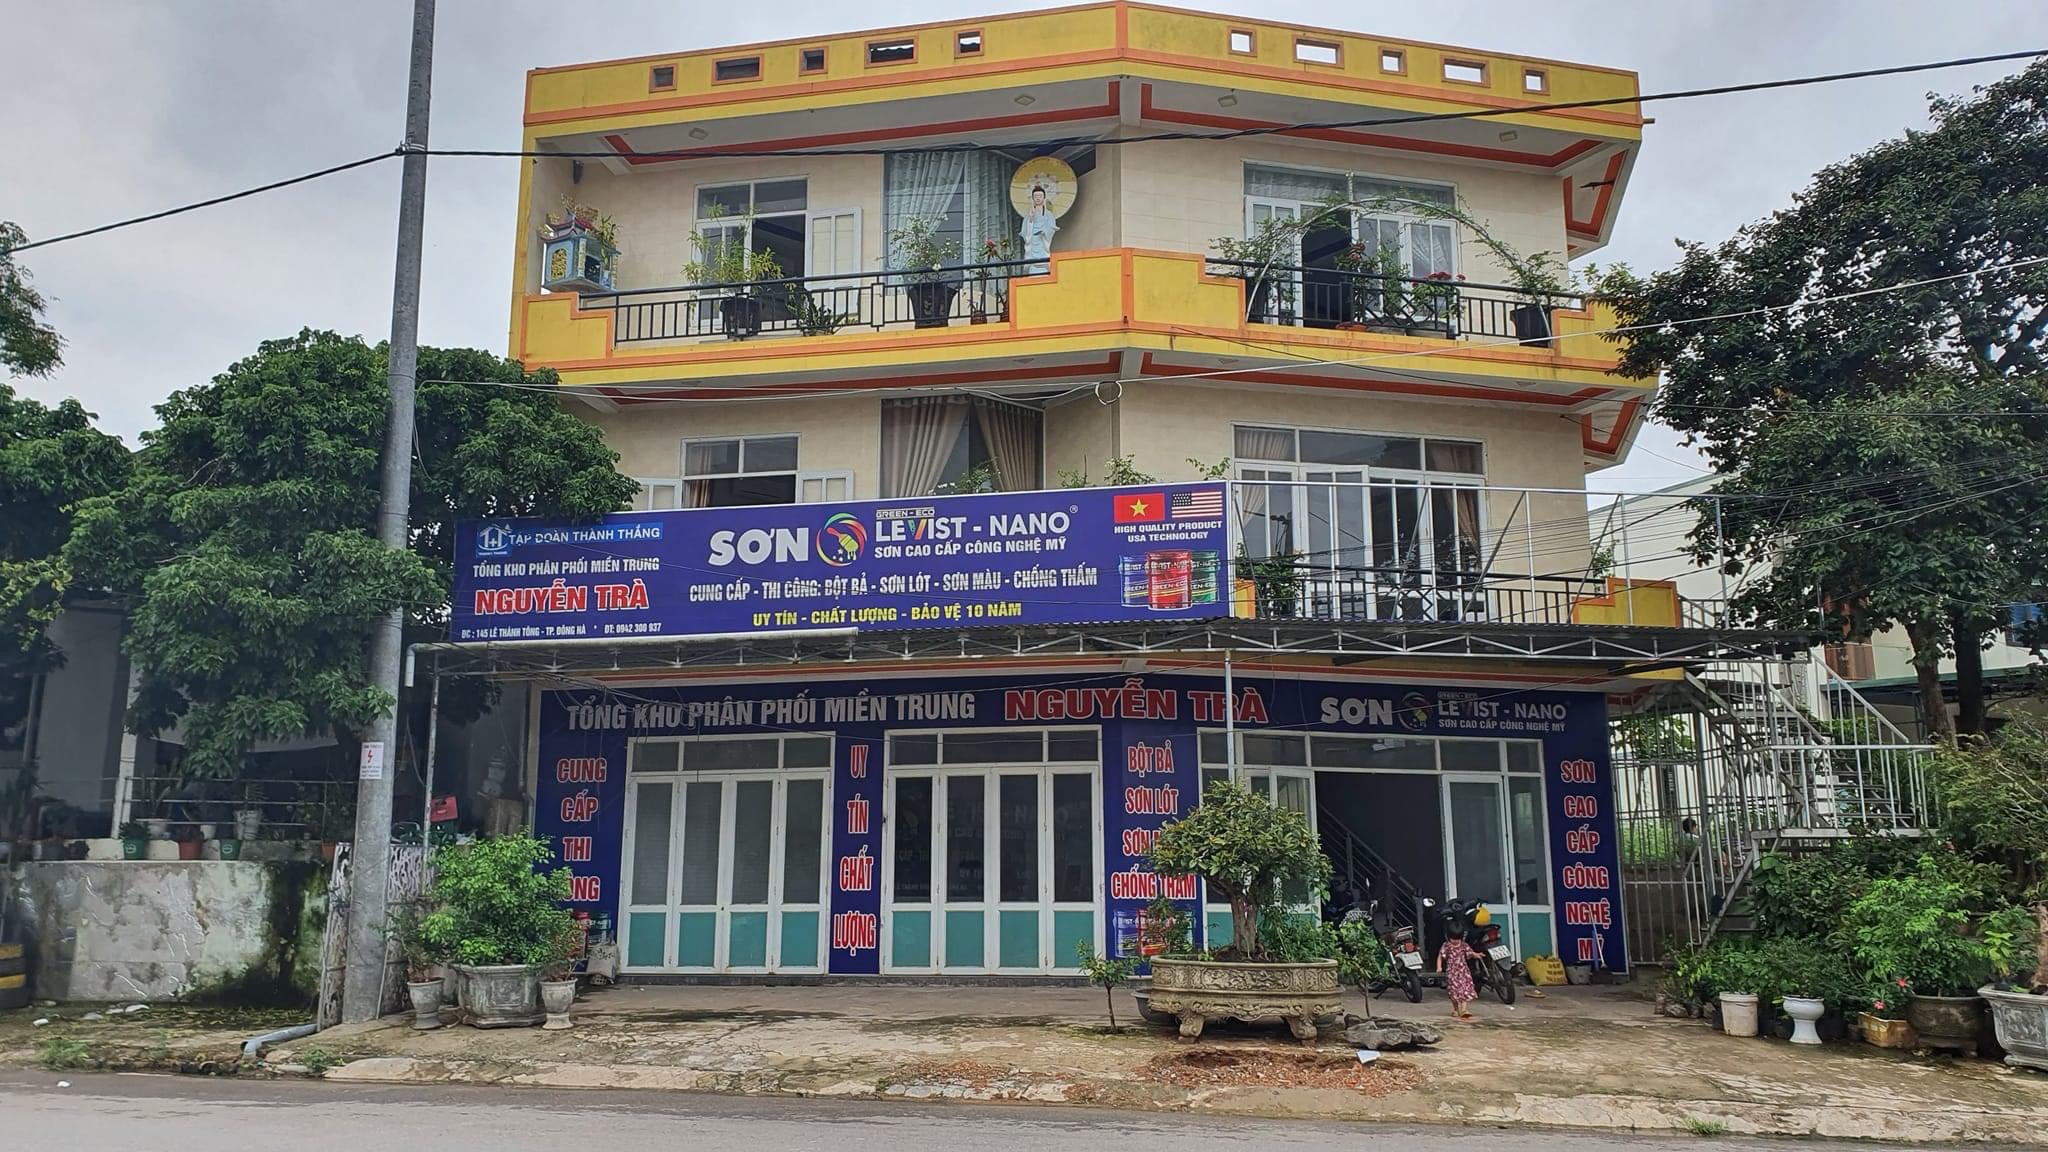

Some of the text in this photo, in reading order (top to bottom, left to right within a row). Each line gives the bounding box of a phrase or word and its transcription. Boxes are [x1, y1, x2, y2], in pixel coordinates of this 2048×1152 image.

[876, 510, 908, 519] GREEN
[915, 508, 935, 517] ECO
[535, 531, 569, 544] ĐOÀN
[573, 527, 614, 541] THÀNH
[617, 524, 661, 539] THẮNG
[875, 517, 967, 542] LEVIST
[1114, 521, 1222, 534] HIGH QUALITY PRODUCT
[1128, 532, 1209, 543] USA TECHNOLOGY
[708, 527, 809, 566] SƠN
[874, 536, 1067, 558] SƠN CAO CẤP CÔNG NGHỆ MỸ
[473, 556, 660, 577] TỔNG KHO PHÂN PHỐI MIỀN TRUNG
[689, 582, 722, 602] CUNG
[726, 576, 751, 601] CẤP
[762, 581, 781, 600] THI
[784, 577, 821, 598] CÔNG:
[824, 575, 848, 600] BỘT
[851, 572, 868, 595] BẢ
[880, 573, 905, 594] SƠN
[908, 571, 931, 593] LÓT
[943, 572, 968, 591] SƠN
[973, 568, 1001, 590] MÀU
[1013, 563, 1057, 589] CHỐNG
[1061, 561, 1098, 587] THẤM
[474, 578, 649, 615] NGUYỄN TRÀ
[753, 613, 771, 626] UY
[774, 610, 797, 626] TÍN
[811, 606, 847, 624] CHẤT
[851, 607, 897, 625] LƯỢNG
[911, 602, 939, 620] BẢO
[943, 601, 961, 621] VỆ
[966, 604, 983, 618] 10
[988, 602, 1022, 617] NĂM
[476, 628, 488, 638] 145
[499, 626, 521, 637] THÁNH
[522, 626, 540, 637] TÔNG
[576, 624, 586, 635] HÀ
[616, 623, 634, 634] 0942
[635, 622, 648, 633] 300
[567, 677, 1269, 731] TỔNG KHO PHÂN PHỐI MIỀN TRUNG NGUYỄN TRÀ
[1320, 696, 1393, 726] SƠN
[1514, 703, 1567, 720] NANO
[1438, 718, 1457, 728] SƠN
[1460, 719, 1477, 729] CAO
[1480, 717, 1497, 729] CẤP
[1500, 719, 1524, 731] CÔNG
[1526, 720, 1549, 732] NGHỆ
[556, 758, 607, 783] CUNG
[850, 744, 869, 779] UY
[1127, 739, 1174, 778] BỘT BẢ
[1560, 758, 1596, 784] SƠN
[561, 788, 598, 822] CẤP
[1125, 783, 1179, 815] SƠN LÓT
[1563, 795, 1598, 818] CAO
[847, 793, 870, 834] TÍN
[562, 836, 593, 862] THI
[1122, 827, 1153, 857] SƠN
[1566, 823, 1600, 854] CẤP
[839, 844, 874, 892] CHẤT
[1562, 862, 1610, 889] CÔNG
[1111, 864, 1157, 901] CHỐNG
[1565, 897, 1612, 930] NGHỆ
[832, 910, 877, 957] LƯỢNG
